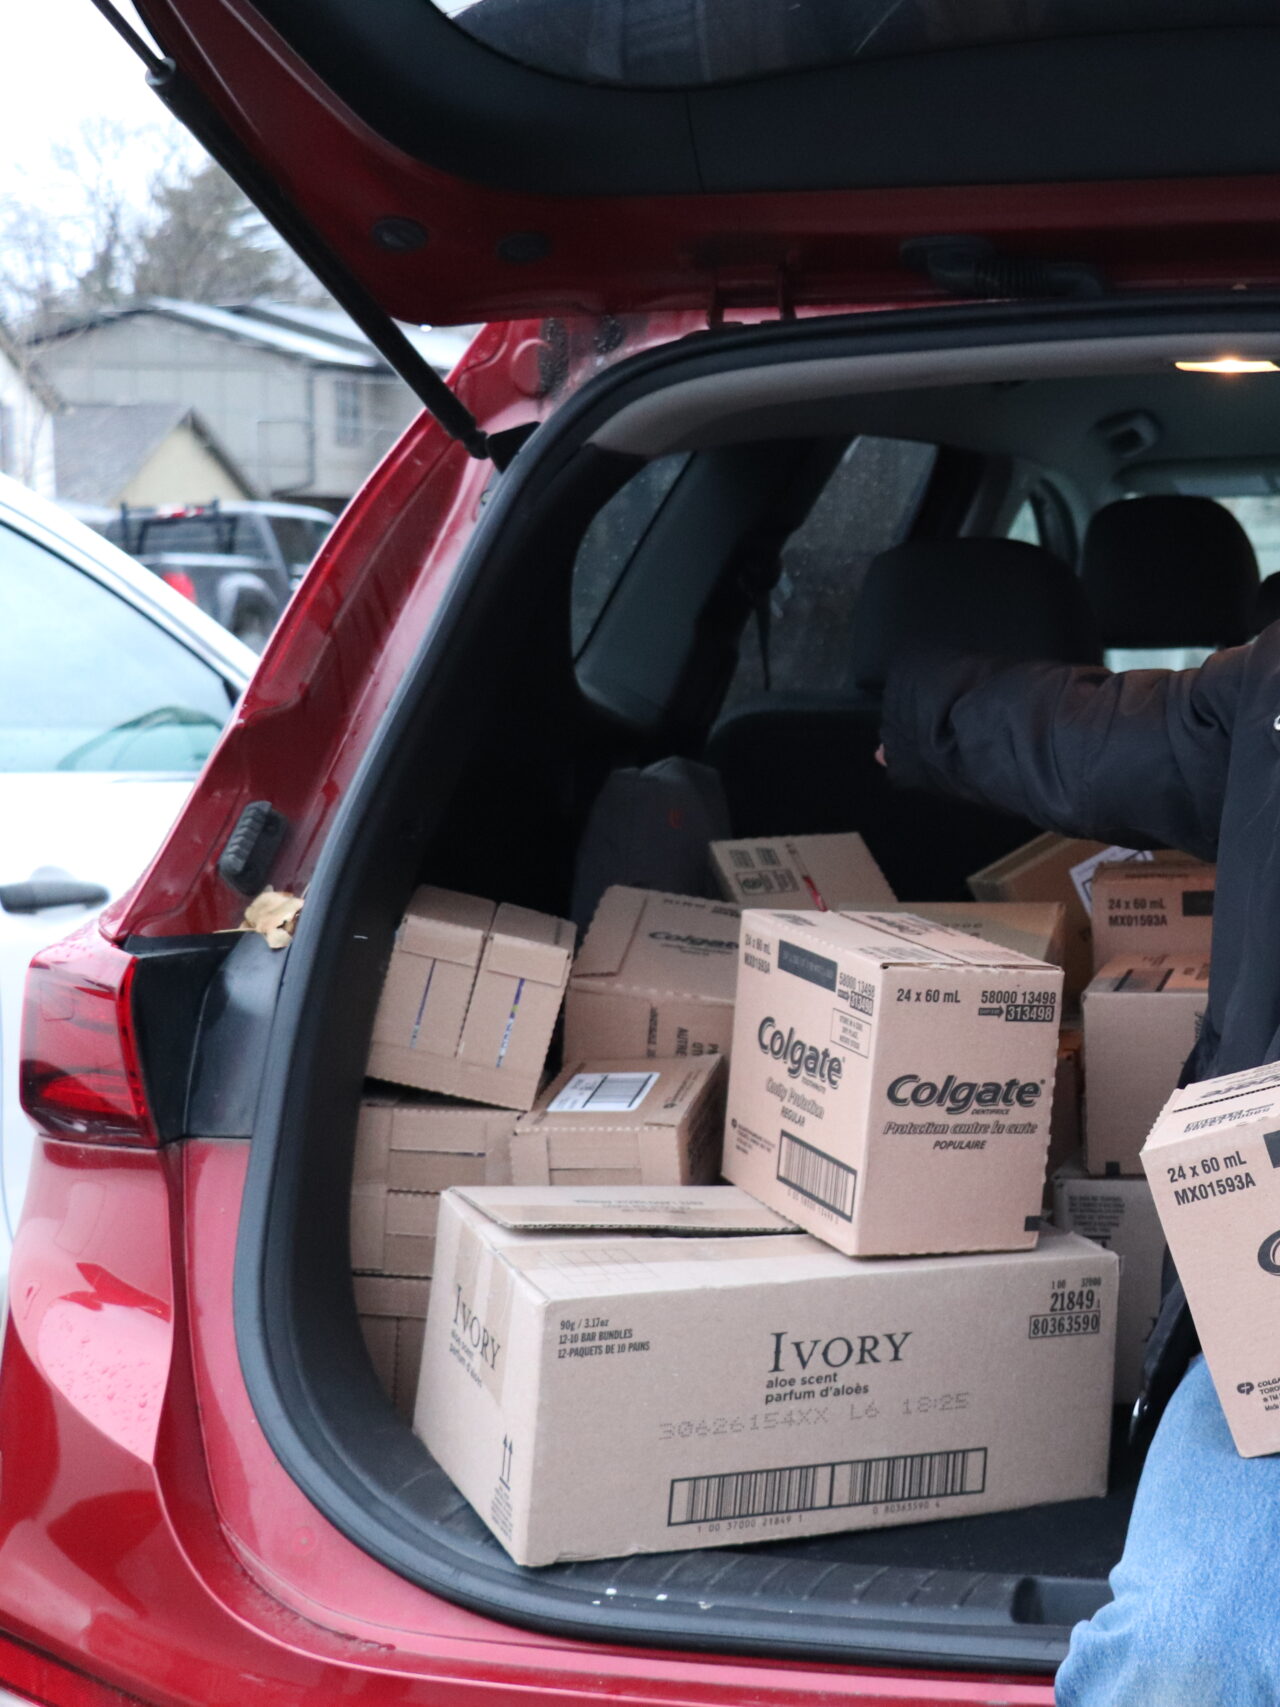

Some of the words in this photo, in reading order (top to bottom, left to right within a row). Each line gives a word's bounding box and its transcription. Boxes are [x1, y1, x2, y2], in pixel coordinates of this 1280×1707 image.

[1108, 897, 1121, 910] 24
[896, 988, 912, 1003] 24
[914, 992, 922, 1002] x
[925, 989, 940, 1003] 60
[943, 990, 961, 1003] mL
[980, 990, 1018, 1004] 58000
[1021, 991, 1057, 1005] 13498
[1007, 1006, 1052, 1021] 313498
[758, 1016, 844, 1090] Colgate
[887, 1074, 1042, 1115] Colgate
[883, 1121, 950, 1135] Protection
[932, 1140, 987, 1150] POPULAIRE
[1167, 1166, 1187, 1183] 24
[1190, 1165, 1199, 1178] x
[1200, 1156, 1220, 1175] 60
[1224, 1151, 1247, 1170] mL
[1174, 1172, 1256, 1205] MX01593A
[1050, 1289, 1095, 1312] 21849
[452, 1283, 500, 1371] IVORY
[560, 1319, 576, 1331] 90g
[1032, 1314, 1098, 1335] 80363590
[559, 1333, 579, 1345] 12-10
[580, 1331, 597, 1342] BAR
[598, 1328, 633, 1341] BUNDLES
[557, 1344, 603, 1359] 12-PAQUETS
[605, 1344, 615, 1354] DE
[617, 1343, 626, 1353] 10
[628, 1341, 650, 1352] PAINS
[768, 1331, 913, 1373] IVORY
[766, 1376, 796, 1389] aloe
[801, 1372, 838, 1386] scent
[765, 1389, 815, 1405] parfum
